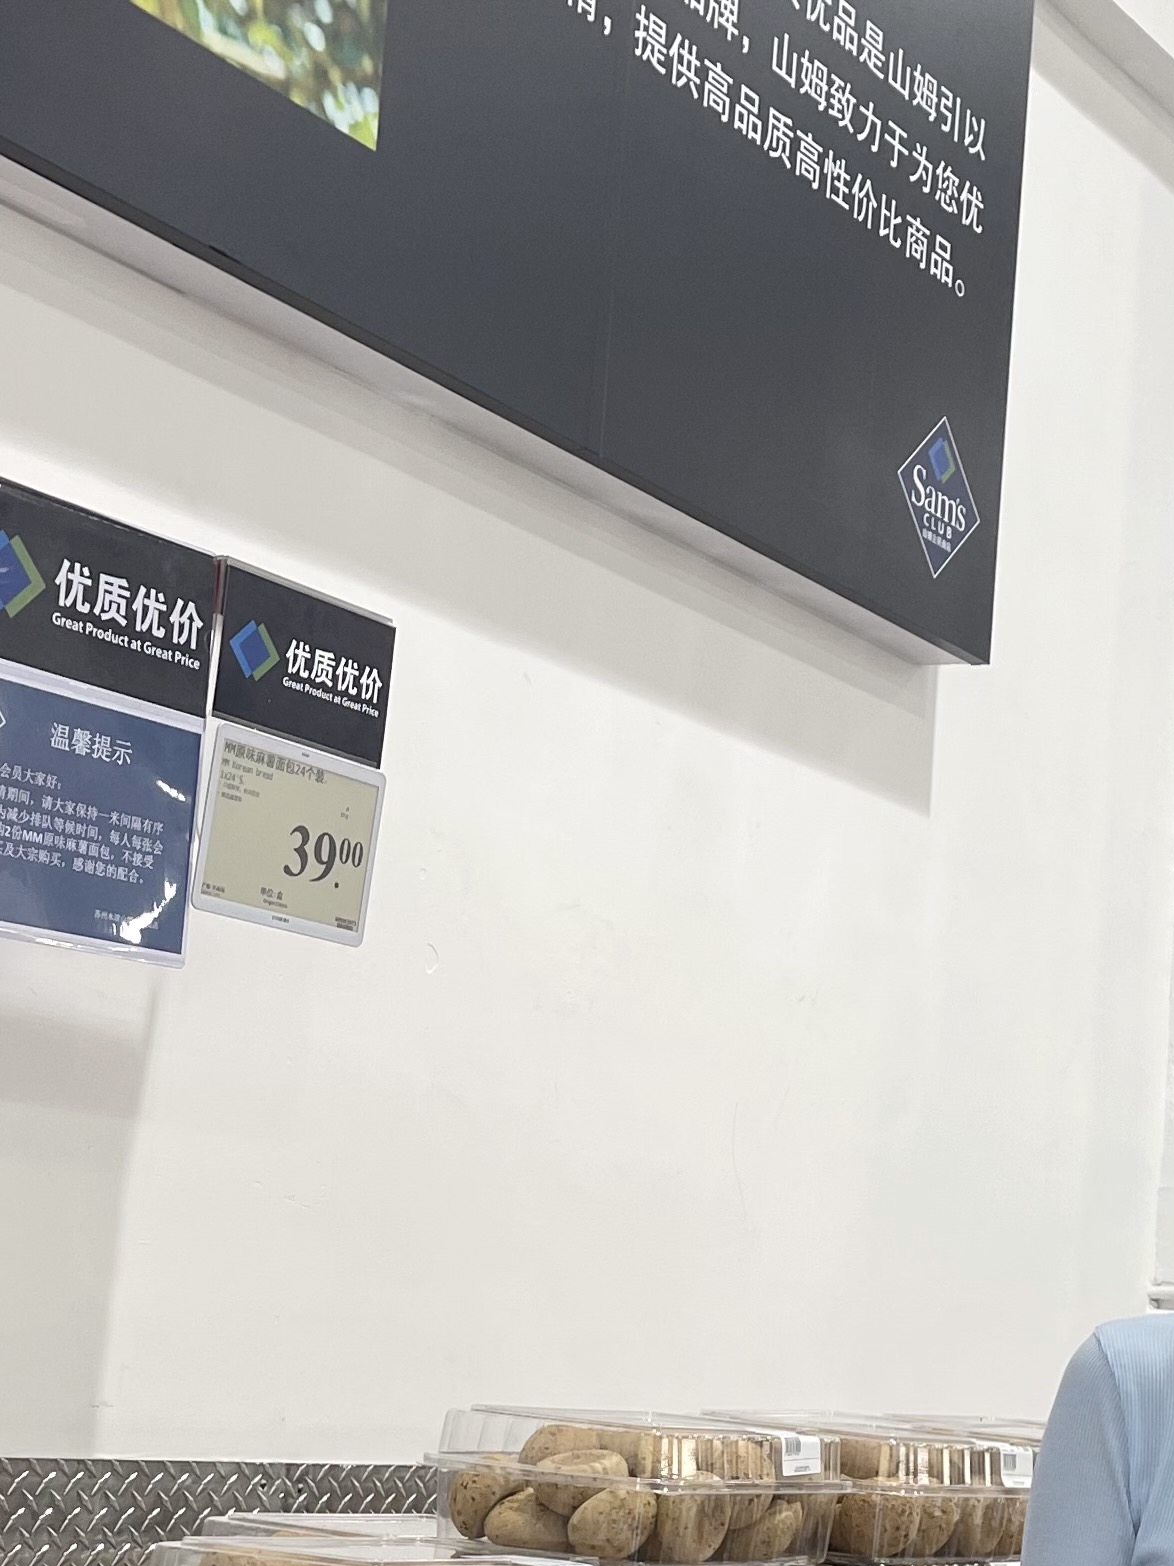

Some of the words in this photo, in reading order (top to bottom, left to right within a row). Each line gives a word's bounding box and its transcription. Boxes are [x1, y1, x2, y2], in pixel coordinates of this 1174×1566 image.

[791, 0, 986, 161] 优品是山姆引以
[684, 0, 985, 234] 牌，山姆致力于为您优
[922, 512, 953, 540] CLUB
[54, 558, 204, 650] 优质优价
[52, 612, 84, 634] Great
[85, 622, 129, 649] Product
[130, 639, 142, 652] at
[143, 641, 173, 663] Great
[174, 650, 200, 670] Price
[285, 638, 383, 704] 优质优价
[282, 676, 304, 692] Great
[304, 683, 333, 703] Product
[333, 695, 341, 705] at
[341, 697, 361, 712] Great
[361, 703, 379, 718] Price
[50, 721, 133, 766] 温馨提示
